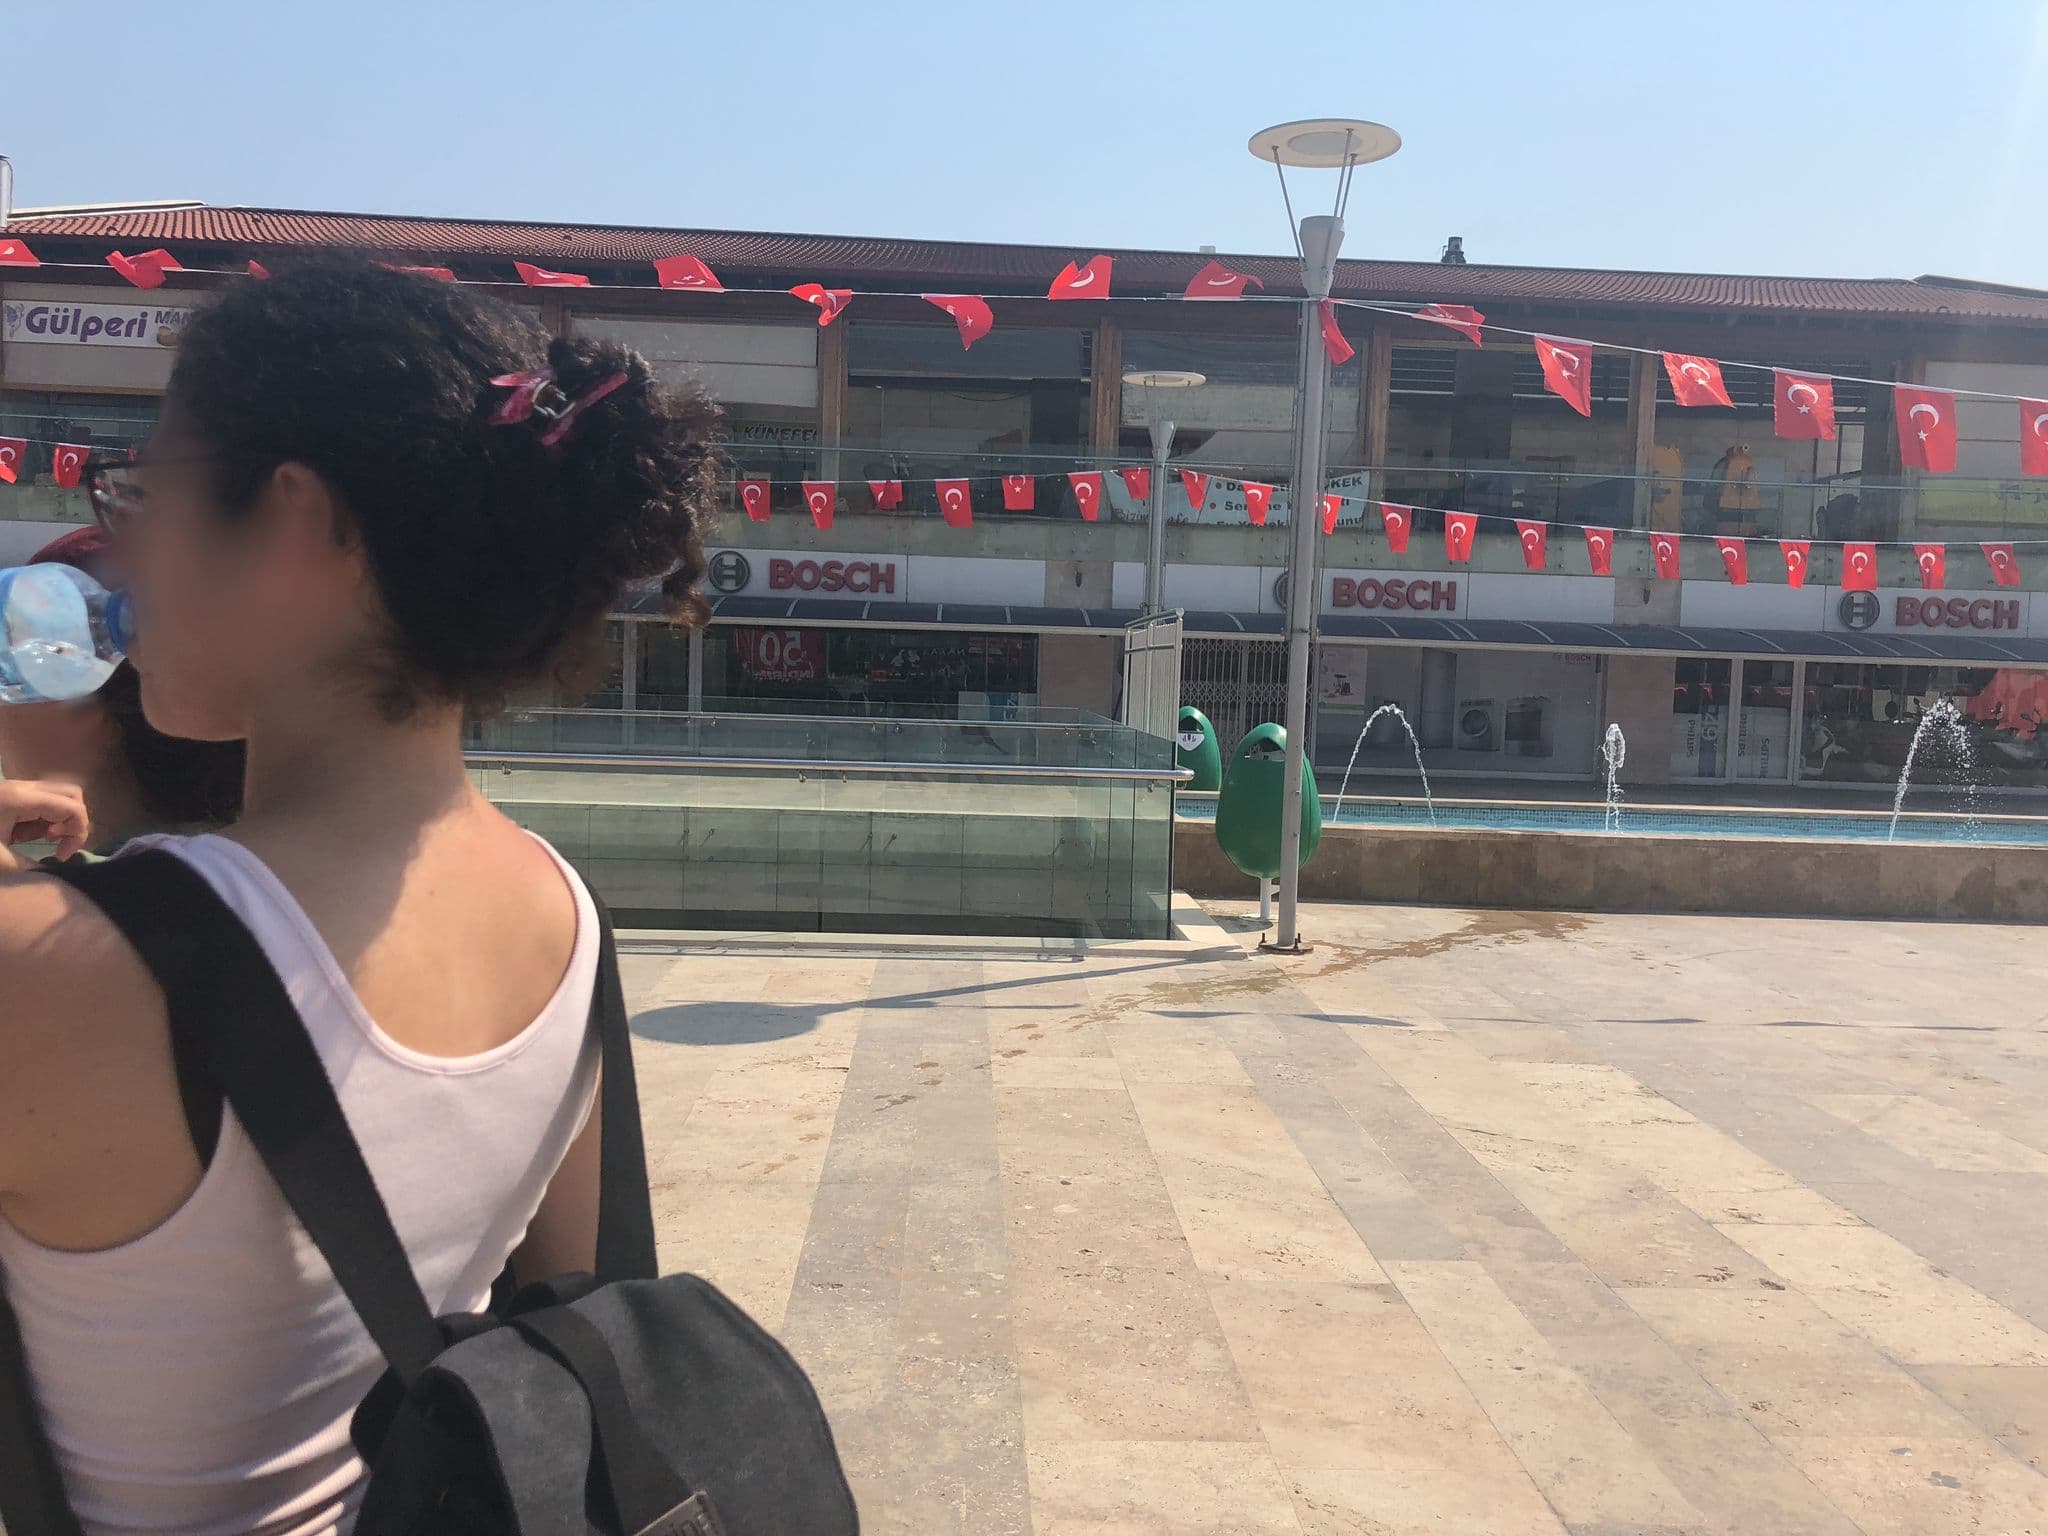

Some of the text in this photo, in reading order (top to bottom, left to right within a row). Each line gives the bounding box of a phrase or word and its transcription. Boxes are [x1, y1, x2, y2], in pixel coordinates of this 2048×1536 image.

[25, 307, 148, 342] Gülperi
[769, 558, 895, 593] BOSCH
[1332, 577, 1457, 611] BOSCH
[1895, 596, 2020, 630] BOSCH
